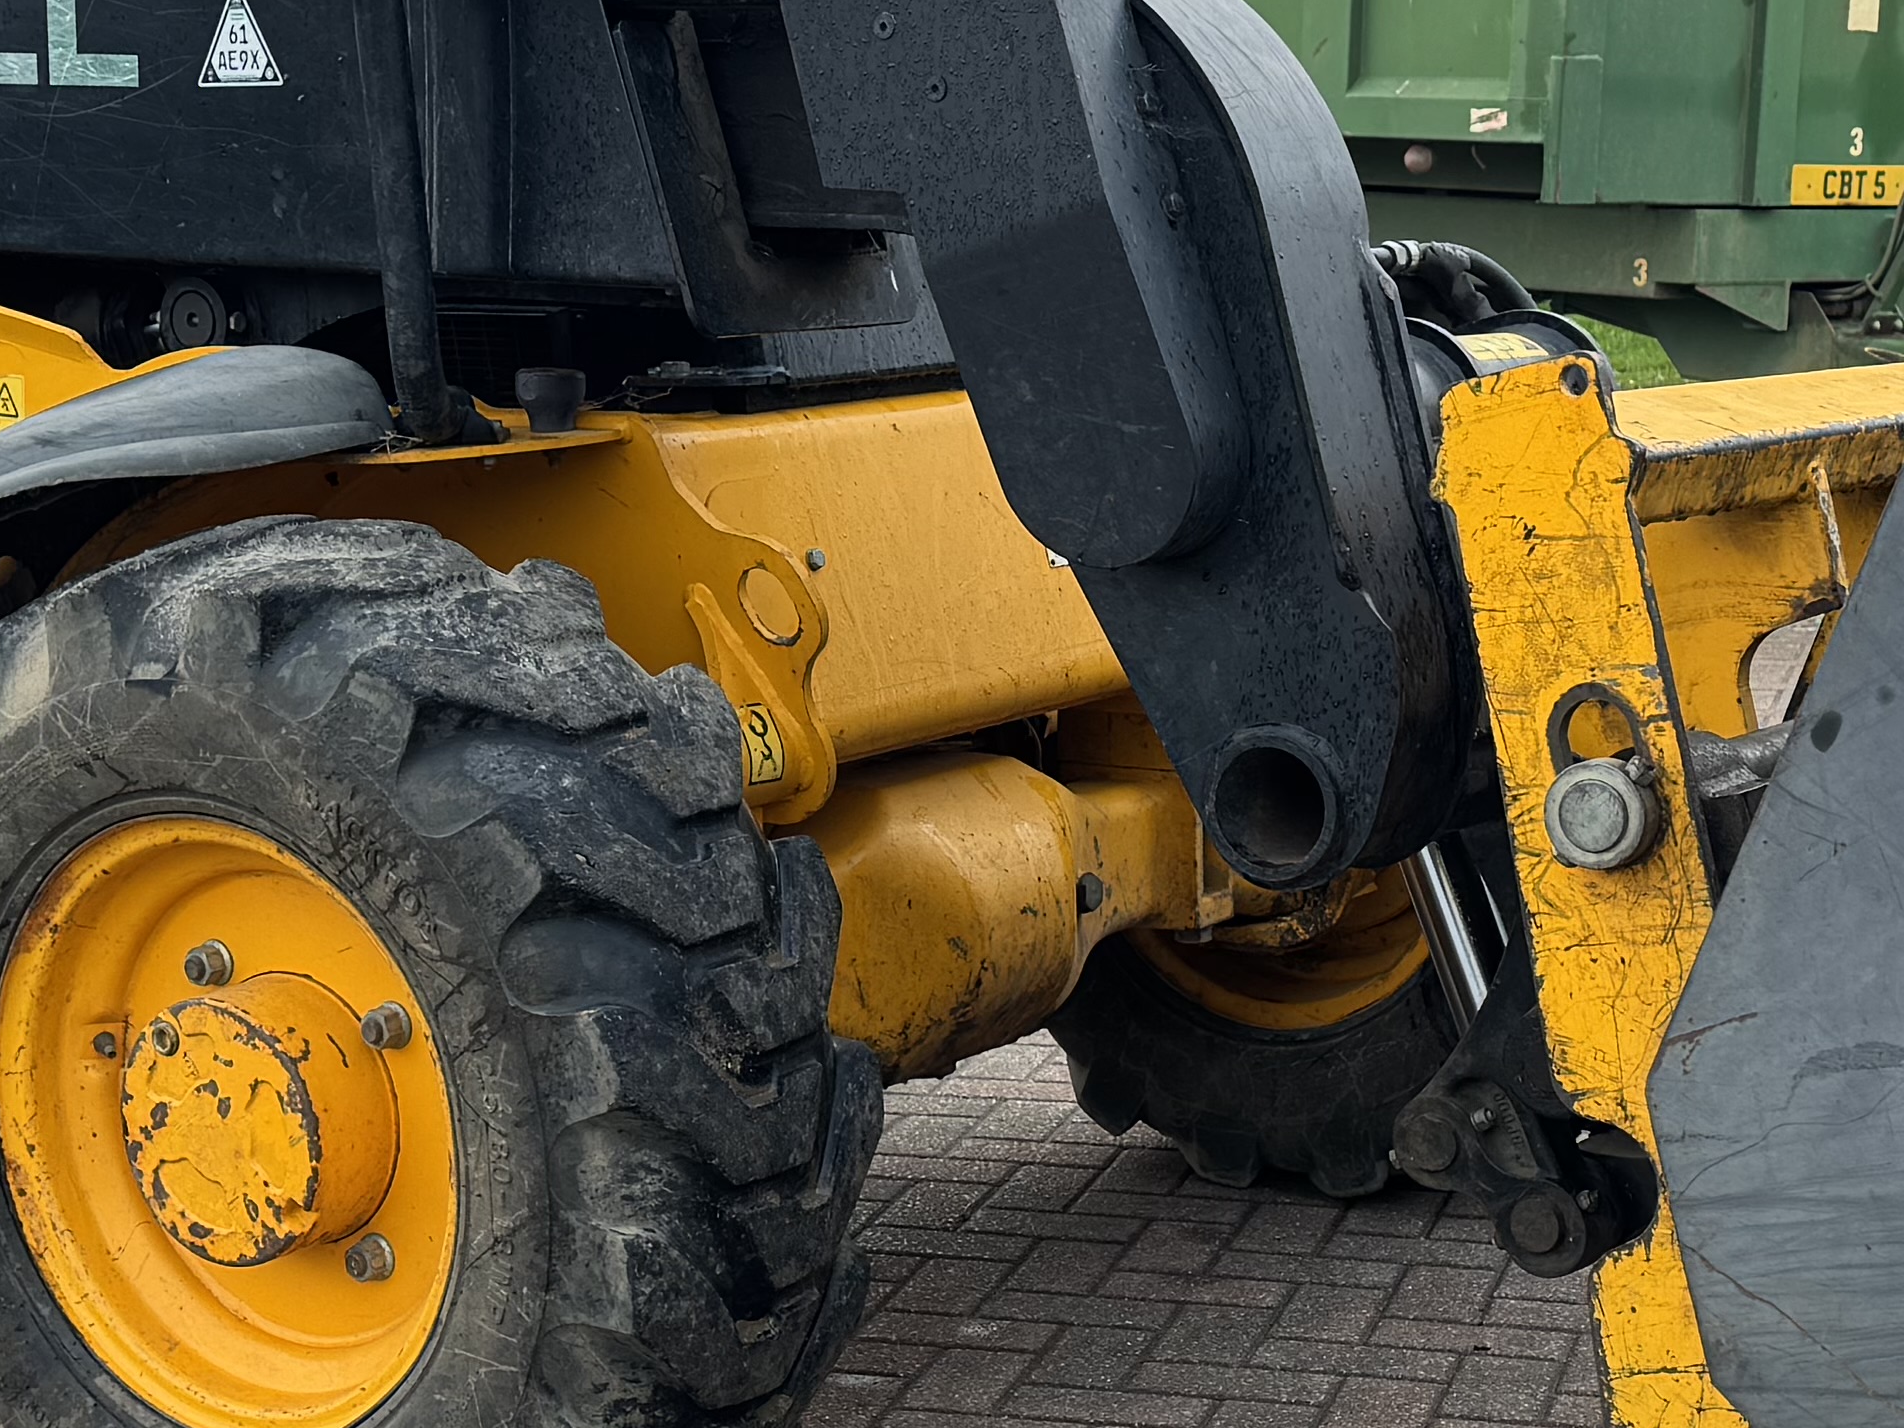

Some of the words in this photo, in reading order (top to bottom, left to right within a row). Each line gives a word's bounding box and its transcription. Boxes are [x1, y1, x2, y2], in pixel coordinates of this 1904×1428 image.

[229, 23, 248, 45] 61
[218, 49, 260, 71] AE9X
[1849, 126, 1864, 157] 3
[1822, 170, 1868, 200] CBT
[1873, 170, 1886, 200] 5
[1632, 257, 1648, 288] 3
